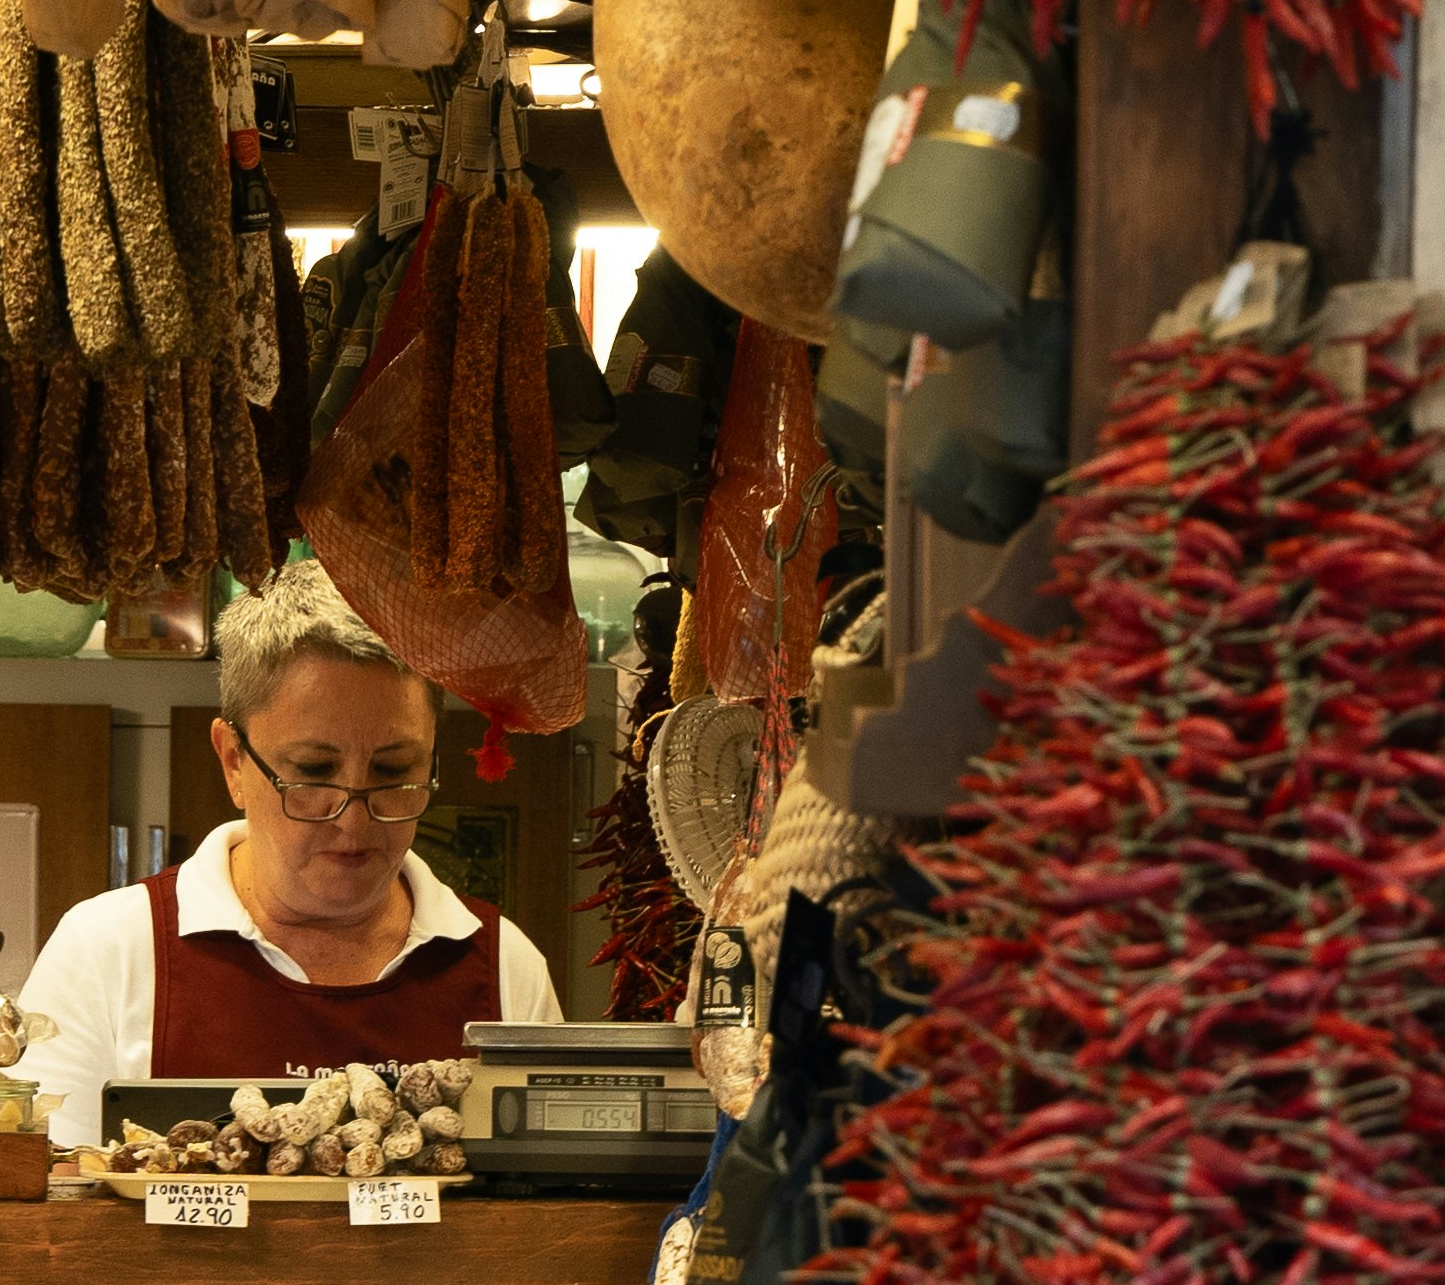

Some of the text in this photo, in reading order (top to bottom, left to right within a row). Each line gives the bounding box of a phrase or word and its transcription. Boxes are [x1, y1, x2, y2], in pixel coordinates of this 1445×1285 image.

[358, 1181, 402, 1194] FUET
[168, 1196, 238, 1207] NATURAL
[355, 1190, 434, 1207] NATURAL
[175, 1207, 233, 1226] 12.90
[380, 1203, 425, 1221] 5.90
